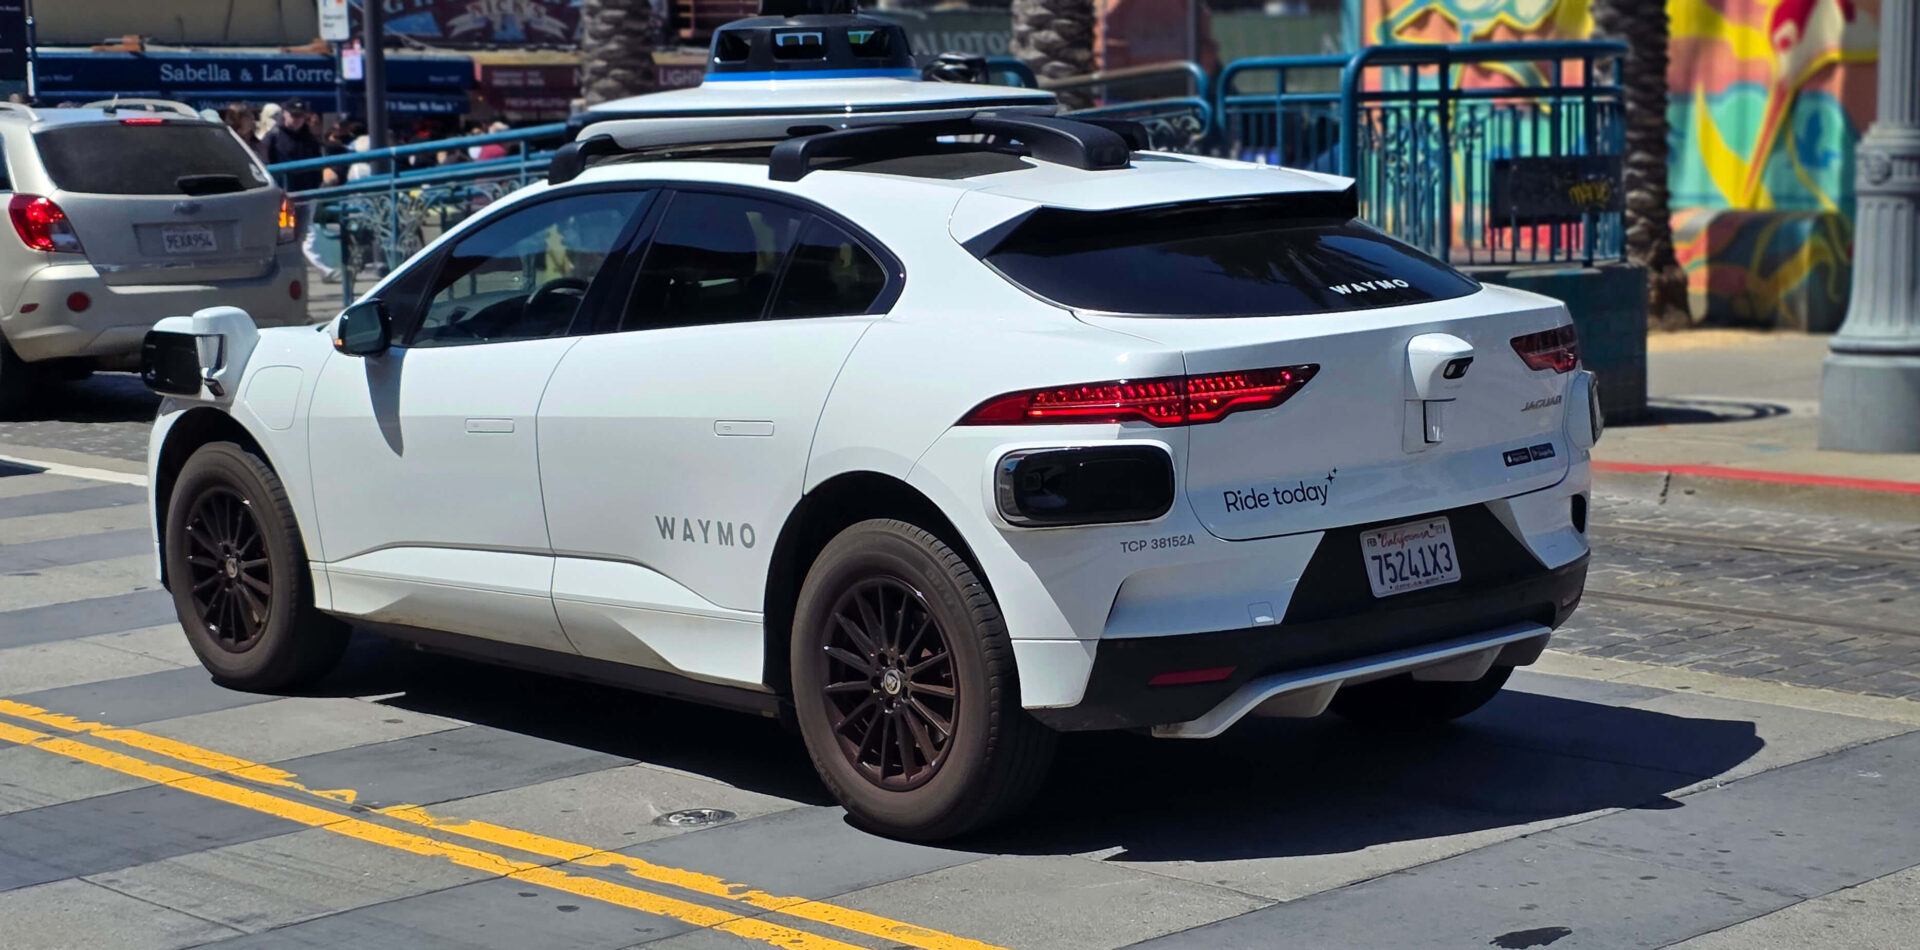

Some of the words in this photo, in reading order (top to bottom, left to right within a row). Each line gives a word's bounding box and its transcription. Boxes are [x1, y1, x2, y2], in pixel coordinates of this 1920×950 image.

[160, 63, 231, 82] Sabella
[240, 69, 253, 82] &
[262, 63, 334, 82] LaTorre
[1328, 279, 1409, 295] WAYMO
[1521, 395, 1562, 412] JAGUAR
[1223, 487, 1270, 513] Ride
[1273, 481, 1328, 506] today
[655, 515, 756, 549] WAYMO
[1120, 540, 1148, 553] TCP
[1151, 533, 1195, 550] 38152A
[1371, 542, 1453, 586] 75241X3
